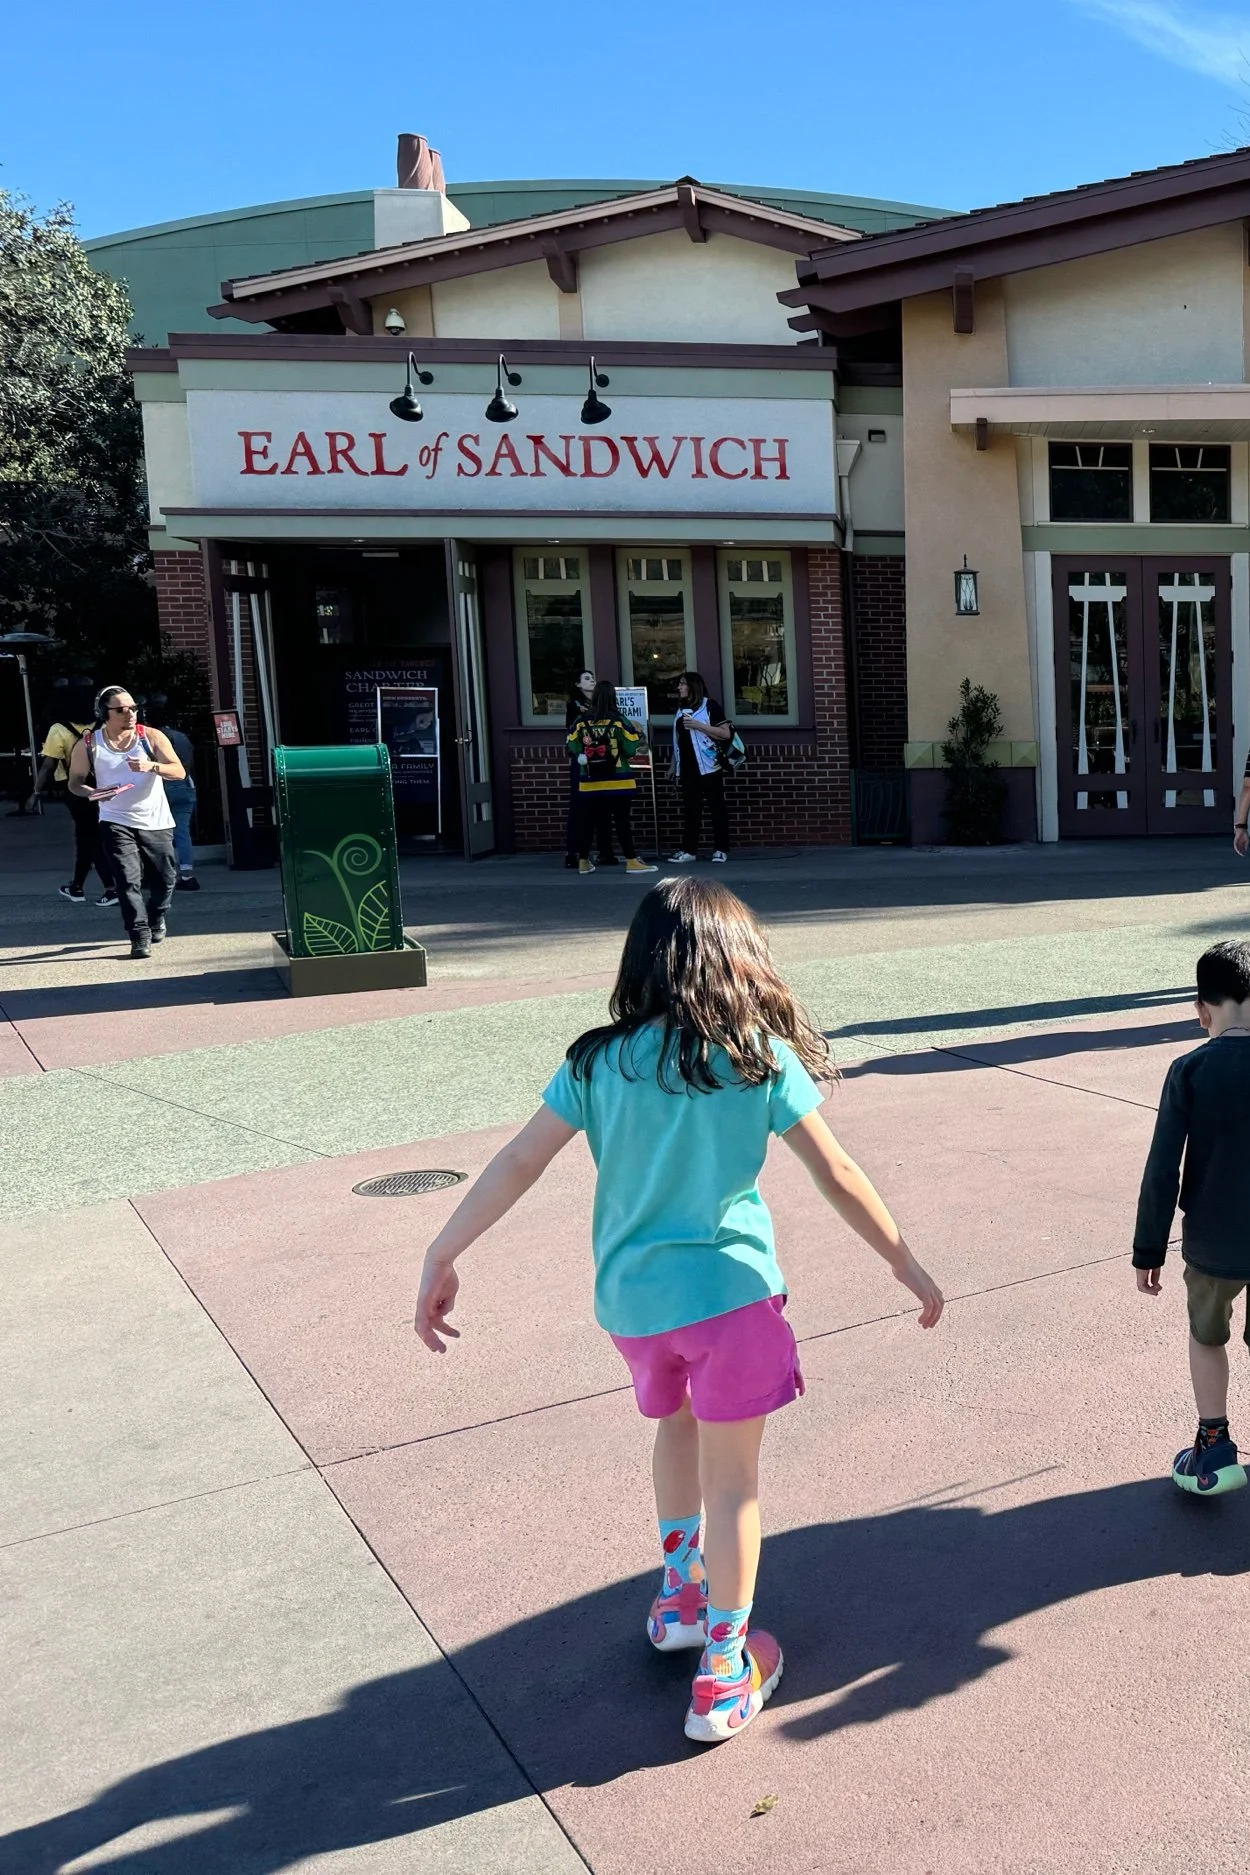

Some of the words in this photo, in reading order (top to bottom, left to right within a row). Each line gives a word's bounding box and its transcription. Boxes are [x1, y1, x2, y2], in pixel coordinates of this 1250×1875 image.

[237, 431, 409, 477] EARL
[418, 431, 450, 480] of
[456, 433, 791, 481] SANDWICH
[344, 670, 428, 680] SANDWICH
[615, 697, 635, 707] ARL'S
[216, 726, 239, 734] STARTS
[401, 762, 435, 770] FAMILY
